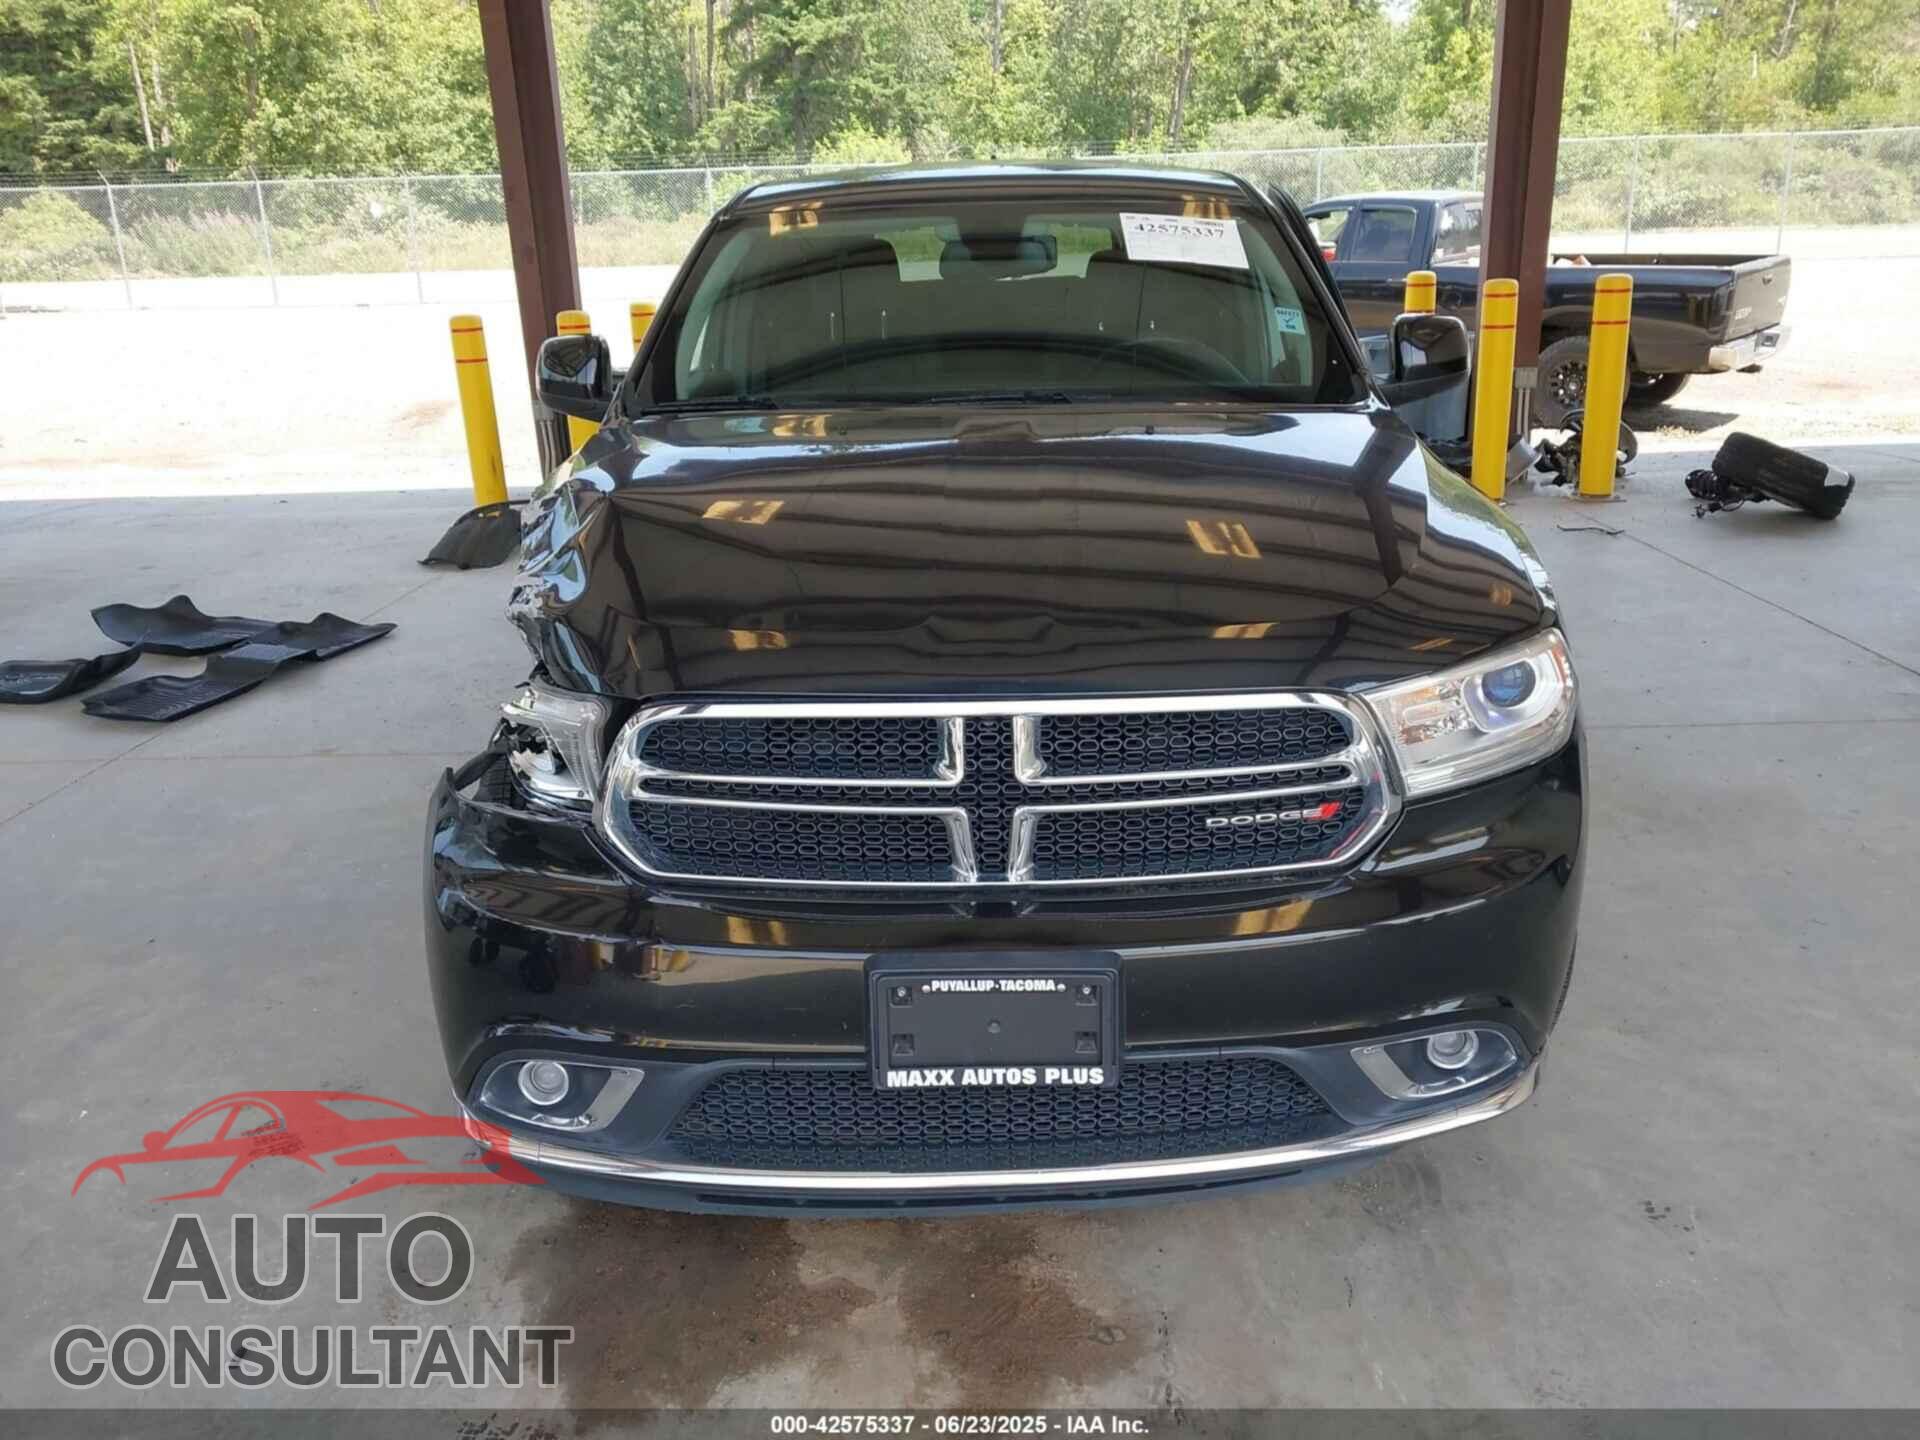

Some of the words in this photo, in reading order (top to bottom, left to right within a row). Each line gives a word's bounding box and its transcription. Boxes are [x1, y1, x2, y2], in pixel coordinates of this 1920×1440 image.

[1206, 809, 1323, 827] DODGE
[887, 1069, 955, 1088] MAXX
[961, 1068, 1037, 1086] AUTOS
[1044, 1067, 1105, 1085] PLUS
